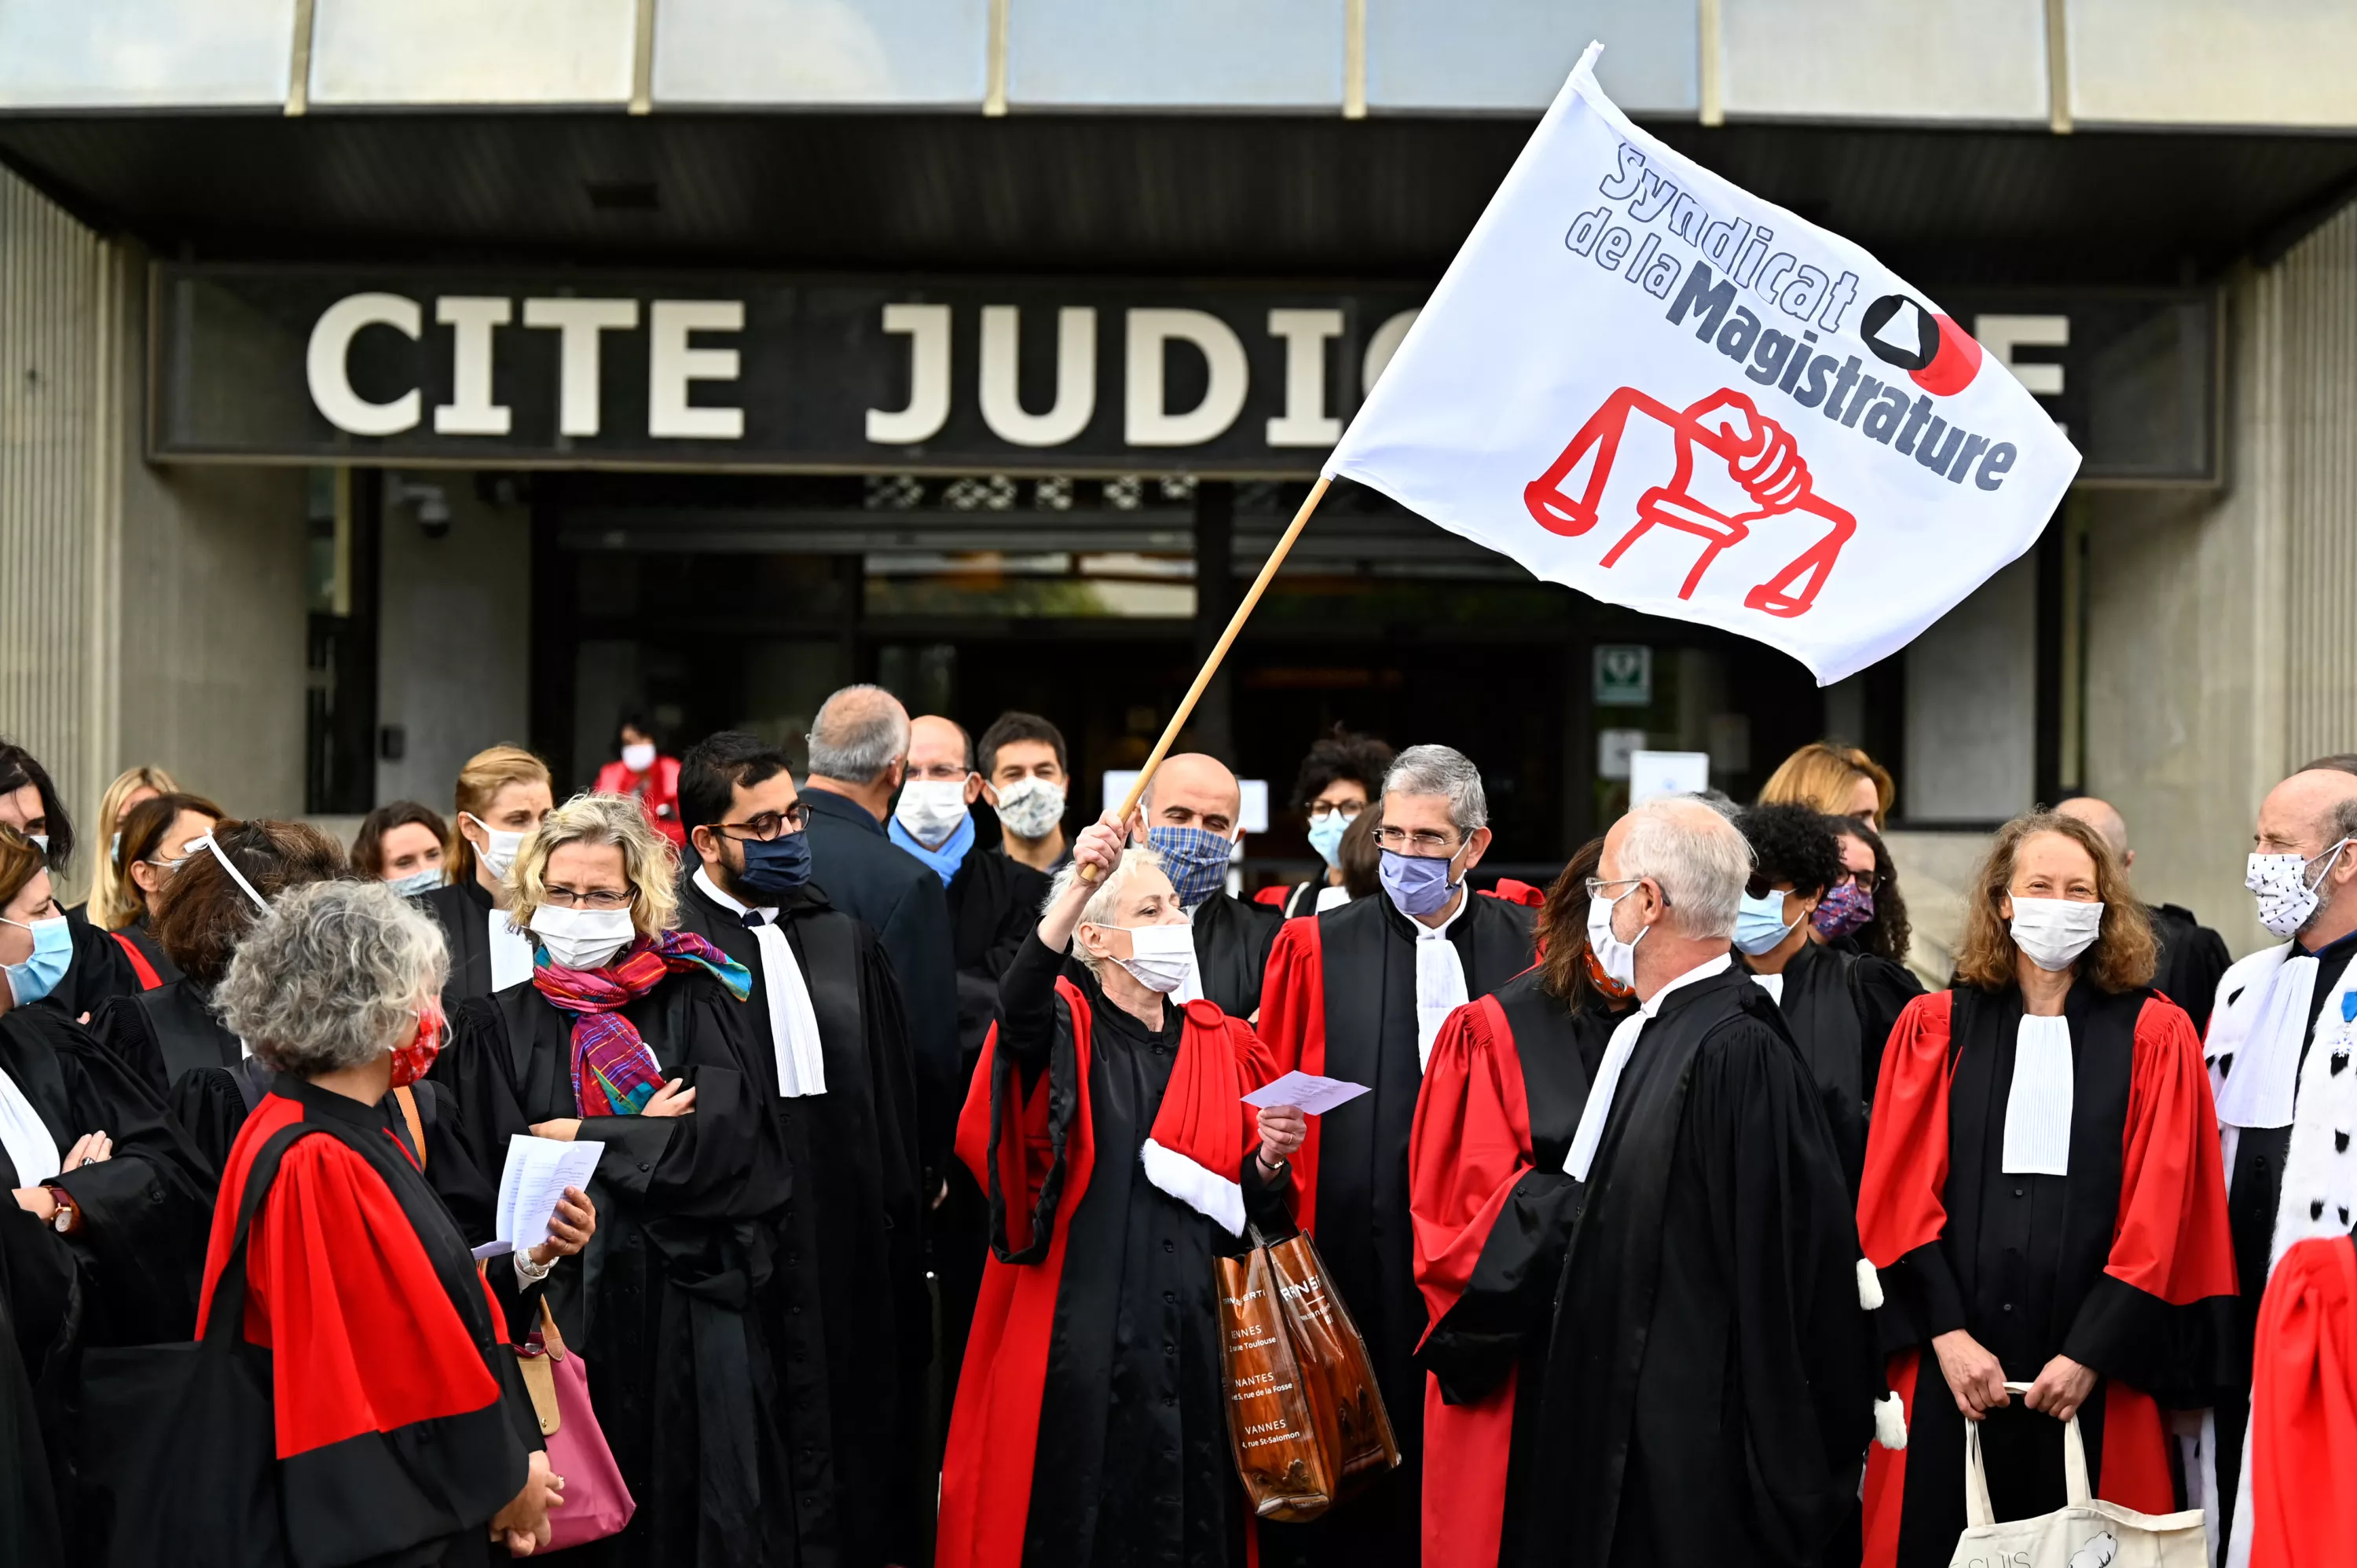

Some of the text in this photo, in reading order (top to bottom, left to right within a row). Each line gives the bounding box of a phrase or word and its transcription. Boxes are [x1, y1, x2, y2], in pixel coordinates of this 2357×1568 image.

[1598, 141, 1859, 334] Syndicat
[1564, 207, 2018, 492] de la Magistrature
[306, 291, 745, 440] CITE
[1244, 1337, 1277, 1350] Toulouse
[1235, 1372, 1274, 1388] NANTES
[1273, 1383, 1292, 1393] Fosse
[1244, 1419, 1286, 1435] VANNES
[1259, 1431, 1300, 1445] St-Salomon
